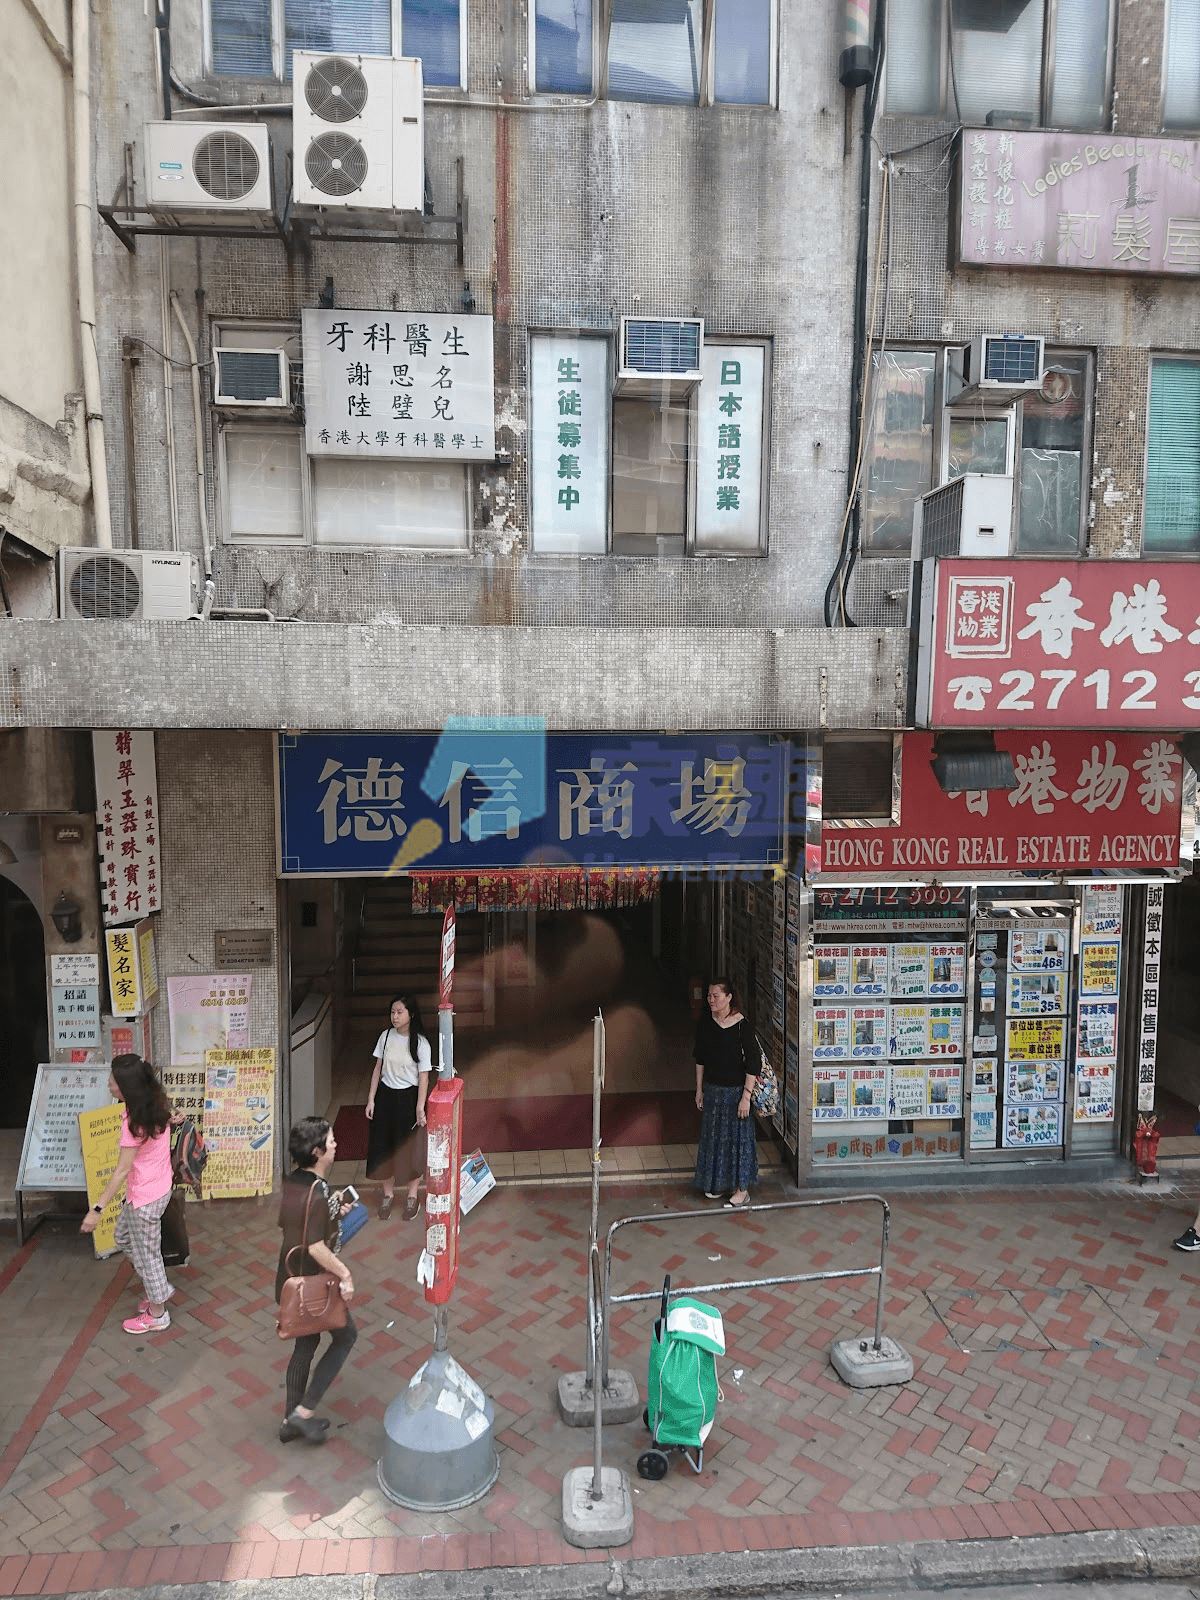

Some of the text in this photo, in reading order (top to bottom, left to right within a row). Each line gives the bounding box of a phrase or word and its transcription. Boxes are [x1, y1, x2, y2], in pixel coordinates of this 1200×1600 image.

[326, 322, 470, 357] 牙科醫生
[345, 362, 453, 389] 謝思名
[348, 393, 454, 420] 陸璧兒
[318, 428, 484, 449] 香港大學牙科醫學士
[716, 361, 743, 510] 日本語授業
[1016, 577, 1200, 659] 香港
[997, 669, 1157, 711] 2712
[316, 756, 753, 844] 德信商場
[824, 834, 1176, 866] HONG KONG REAL ESTATE AGENCY
[111, 934, 134, 997] 髮名家
[1139, 887, 1162, 1083] 誠徵本區租售樓盤
